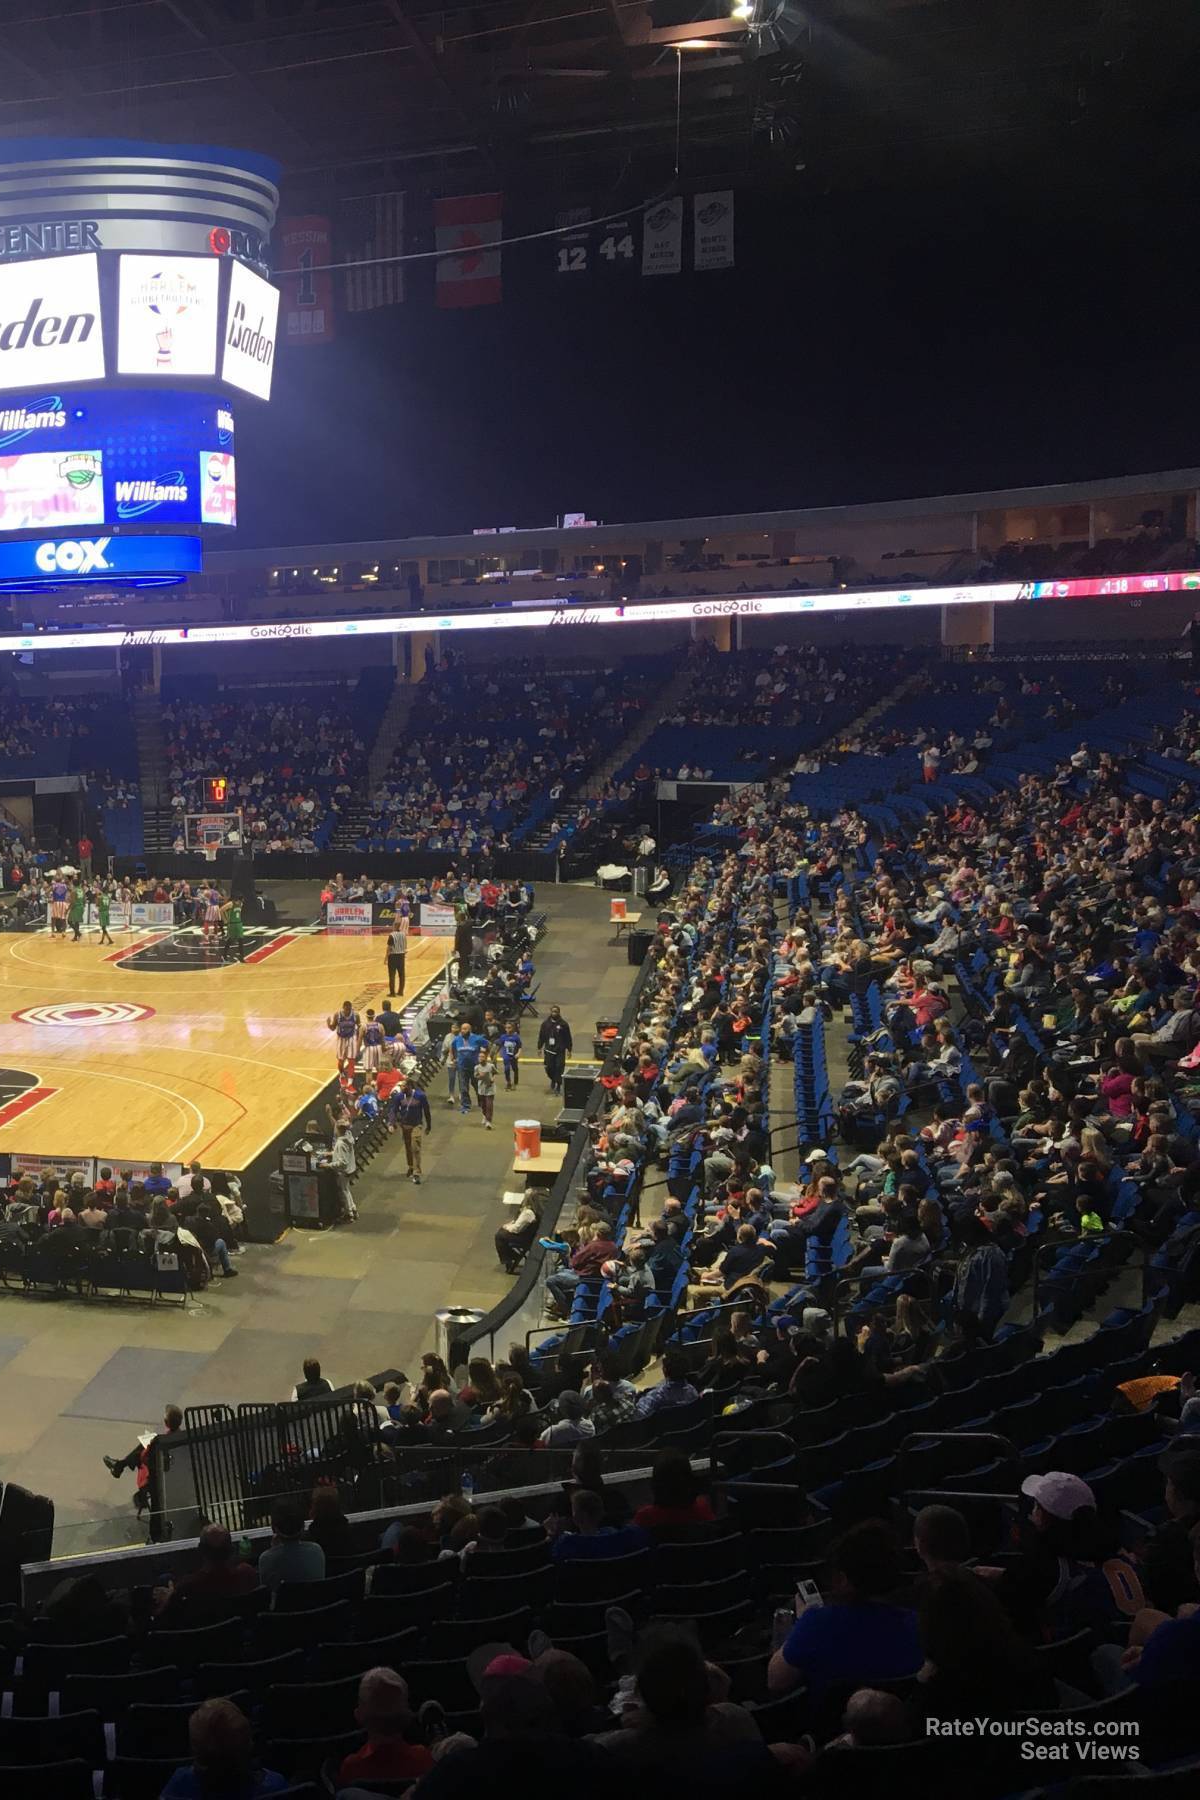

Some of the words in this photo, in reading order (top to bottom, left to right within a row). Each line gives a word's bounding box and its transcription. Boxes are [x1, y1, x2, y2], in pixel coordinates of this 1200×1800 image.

[558, 246, 588, 273] 12
[599, 235, 635, 261] 44
[226, 300, 274, 367] Baden
[115, 481, 188, 503] Williams
[36, 537, 112, 574] COX
[692, 600, 763, 616] GoNoodle
[250, 624, 314, 638] GoNoodle
